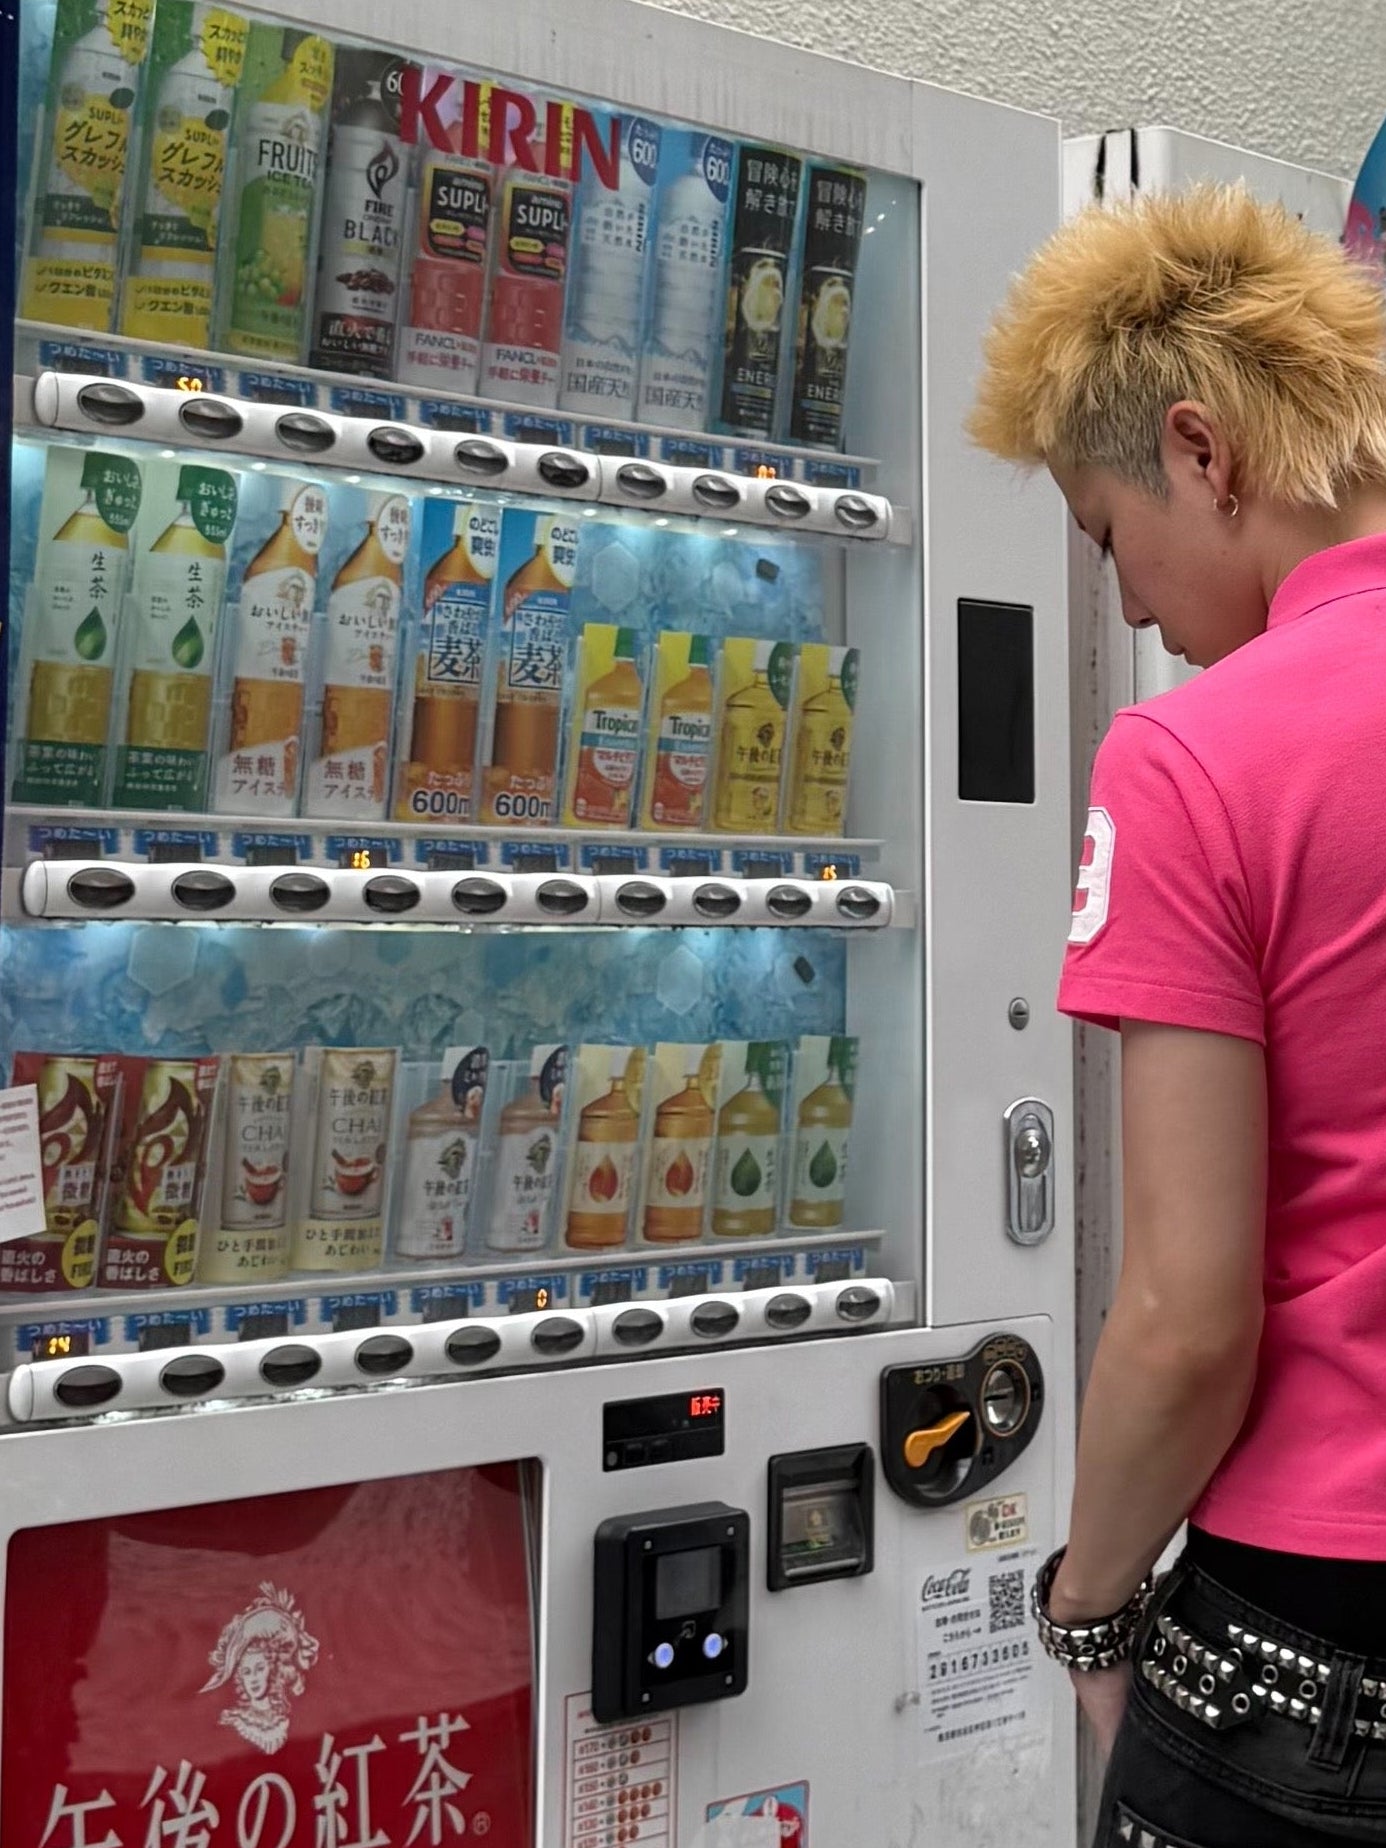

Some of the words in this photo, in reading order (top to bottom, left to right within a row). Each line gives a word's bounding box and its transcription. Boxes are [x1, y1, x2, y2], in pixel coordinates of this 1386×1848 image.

[400, 66, 622, 192] KIRIN
[88, 551, 108, 600] 生茶
[184, 562, 204, 610] 生茶
[432, 635, 484, 680] 麦茶
[512, 643, 564, 687] 麦茶
[231, 754, 276, 778] 無糖
[322, 759, 367, 782] 無糖
[105, 1266, 159, 1282] 香ばしさ
[107, 1248, 150, 1266] 直火の
